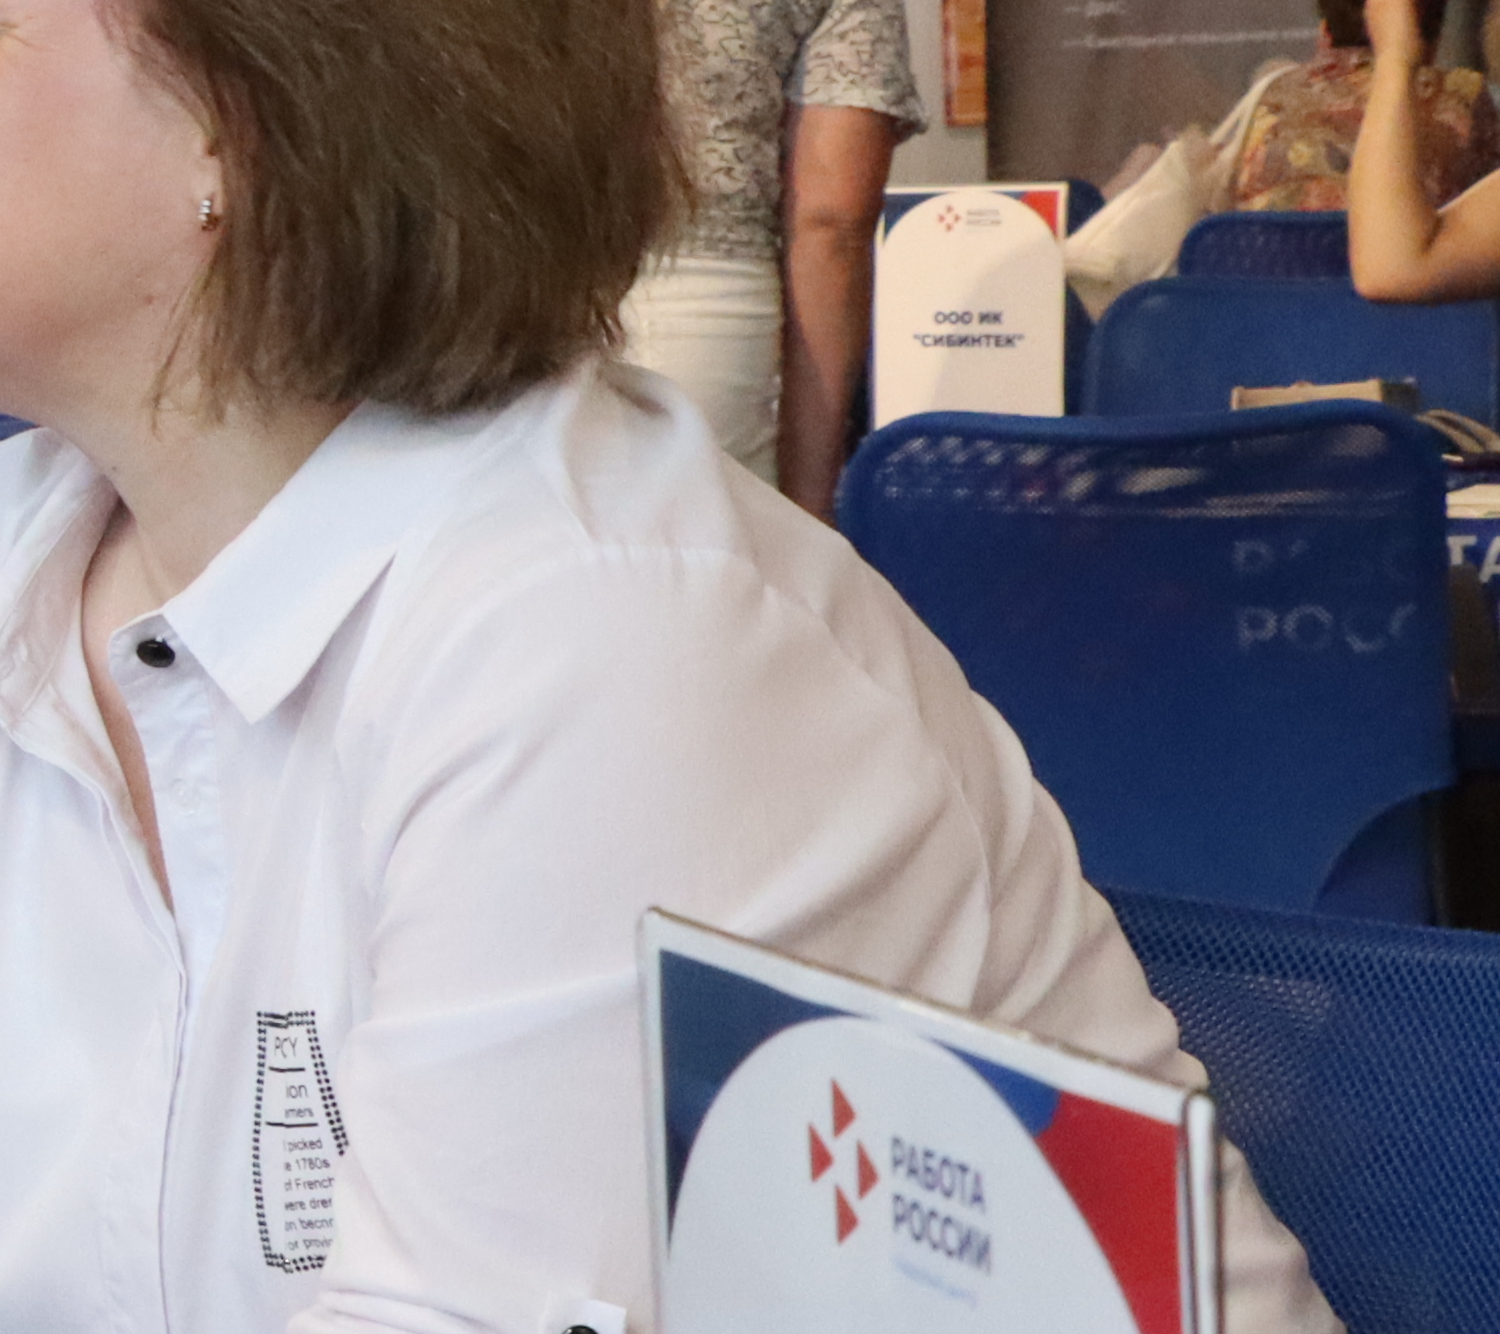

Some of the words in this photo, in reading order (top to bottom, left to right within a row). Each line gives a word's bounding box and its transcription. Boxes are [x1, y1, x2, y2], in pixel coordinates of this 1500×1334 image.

[934, 311, 974, 325] ООО
[891, 1135, 987, 1217] РАБОТА
[892, 1191, 993, 1278] РОССИИ
